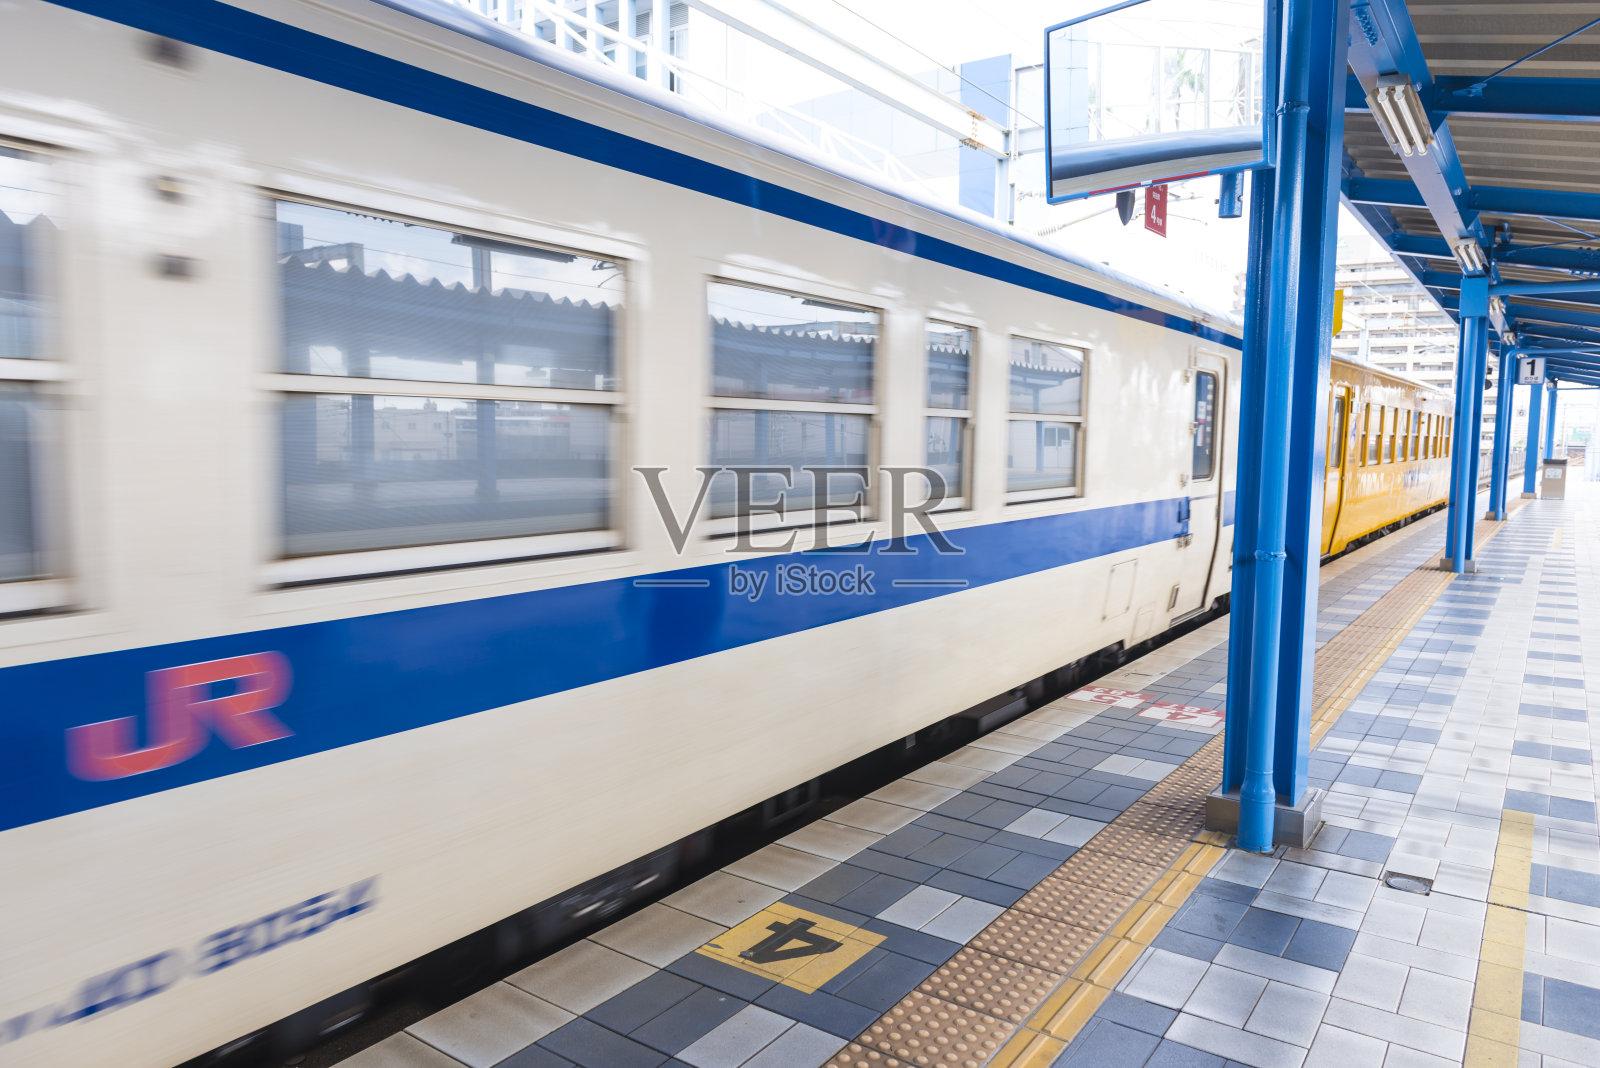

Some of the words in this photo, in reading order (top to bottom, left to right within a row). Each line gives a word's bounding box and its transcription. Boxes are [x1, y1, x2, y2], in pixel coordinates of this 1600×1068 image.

[1526, 359, 1536, 376] 1
[65, 650, 296, 782] JR
[1167, 711, 1198, 720] 4
[737, 917, 844, 965] 4
